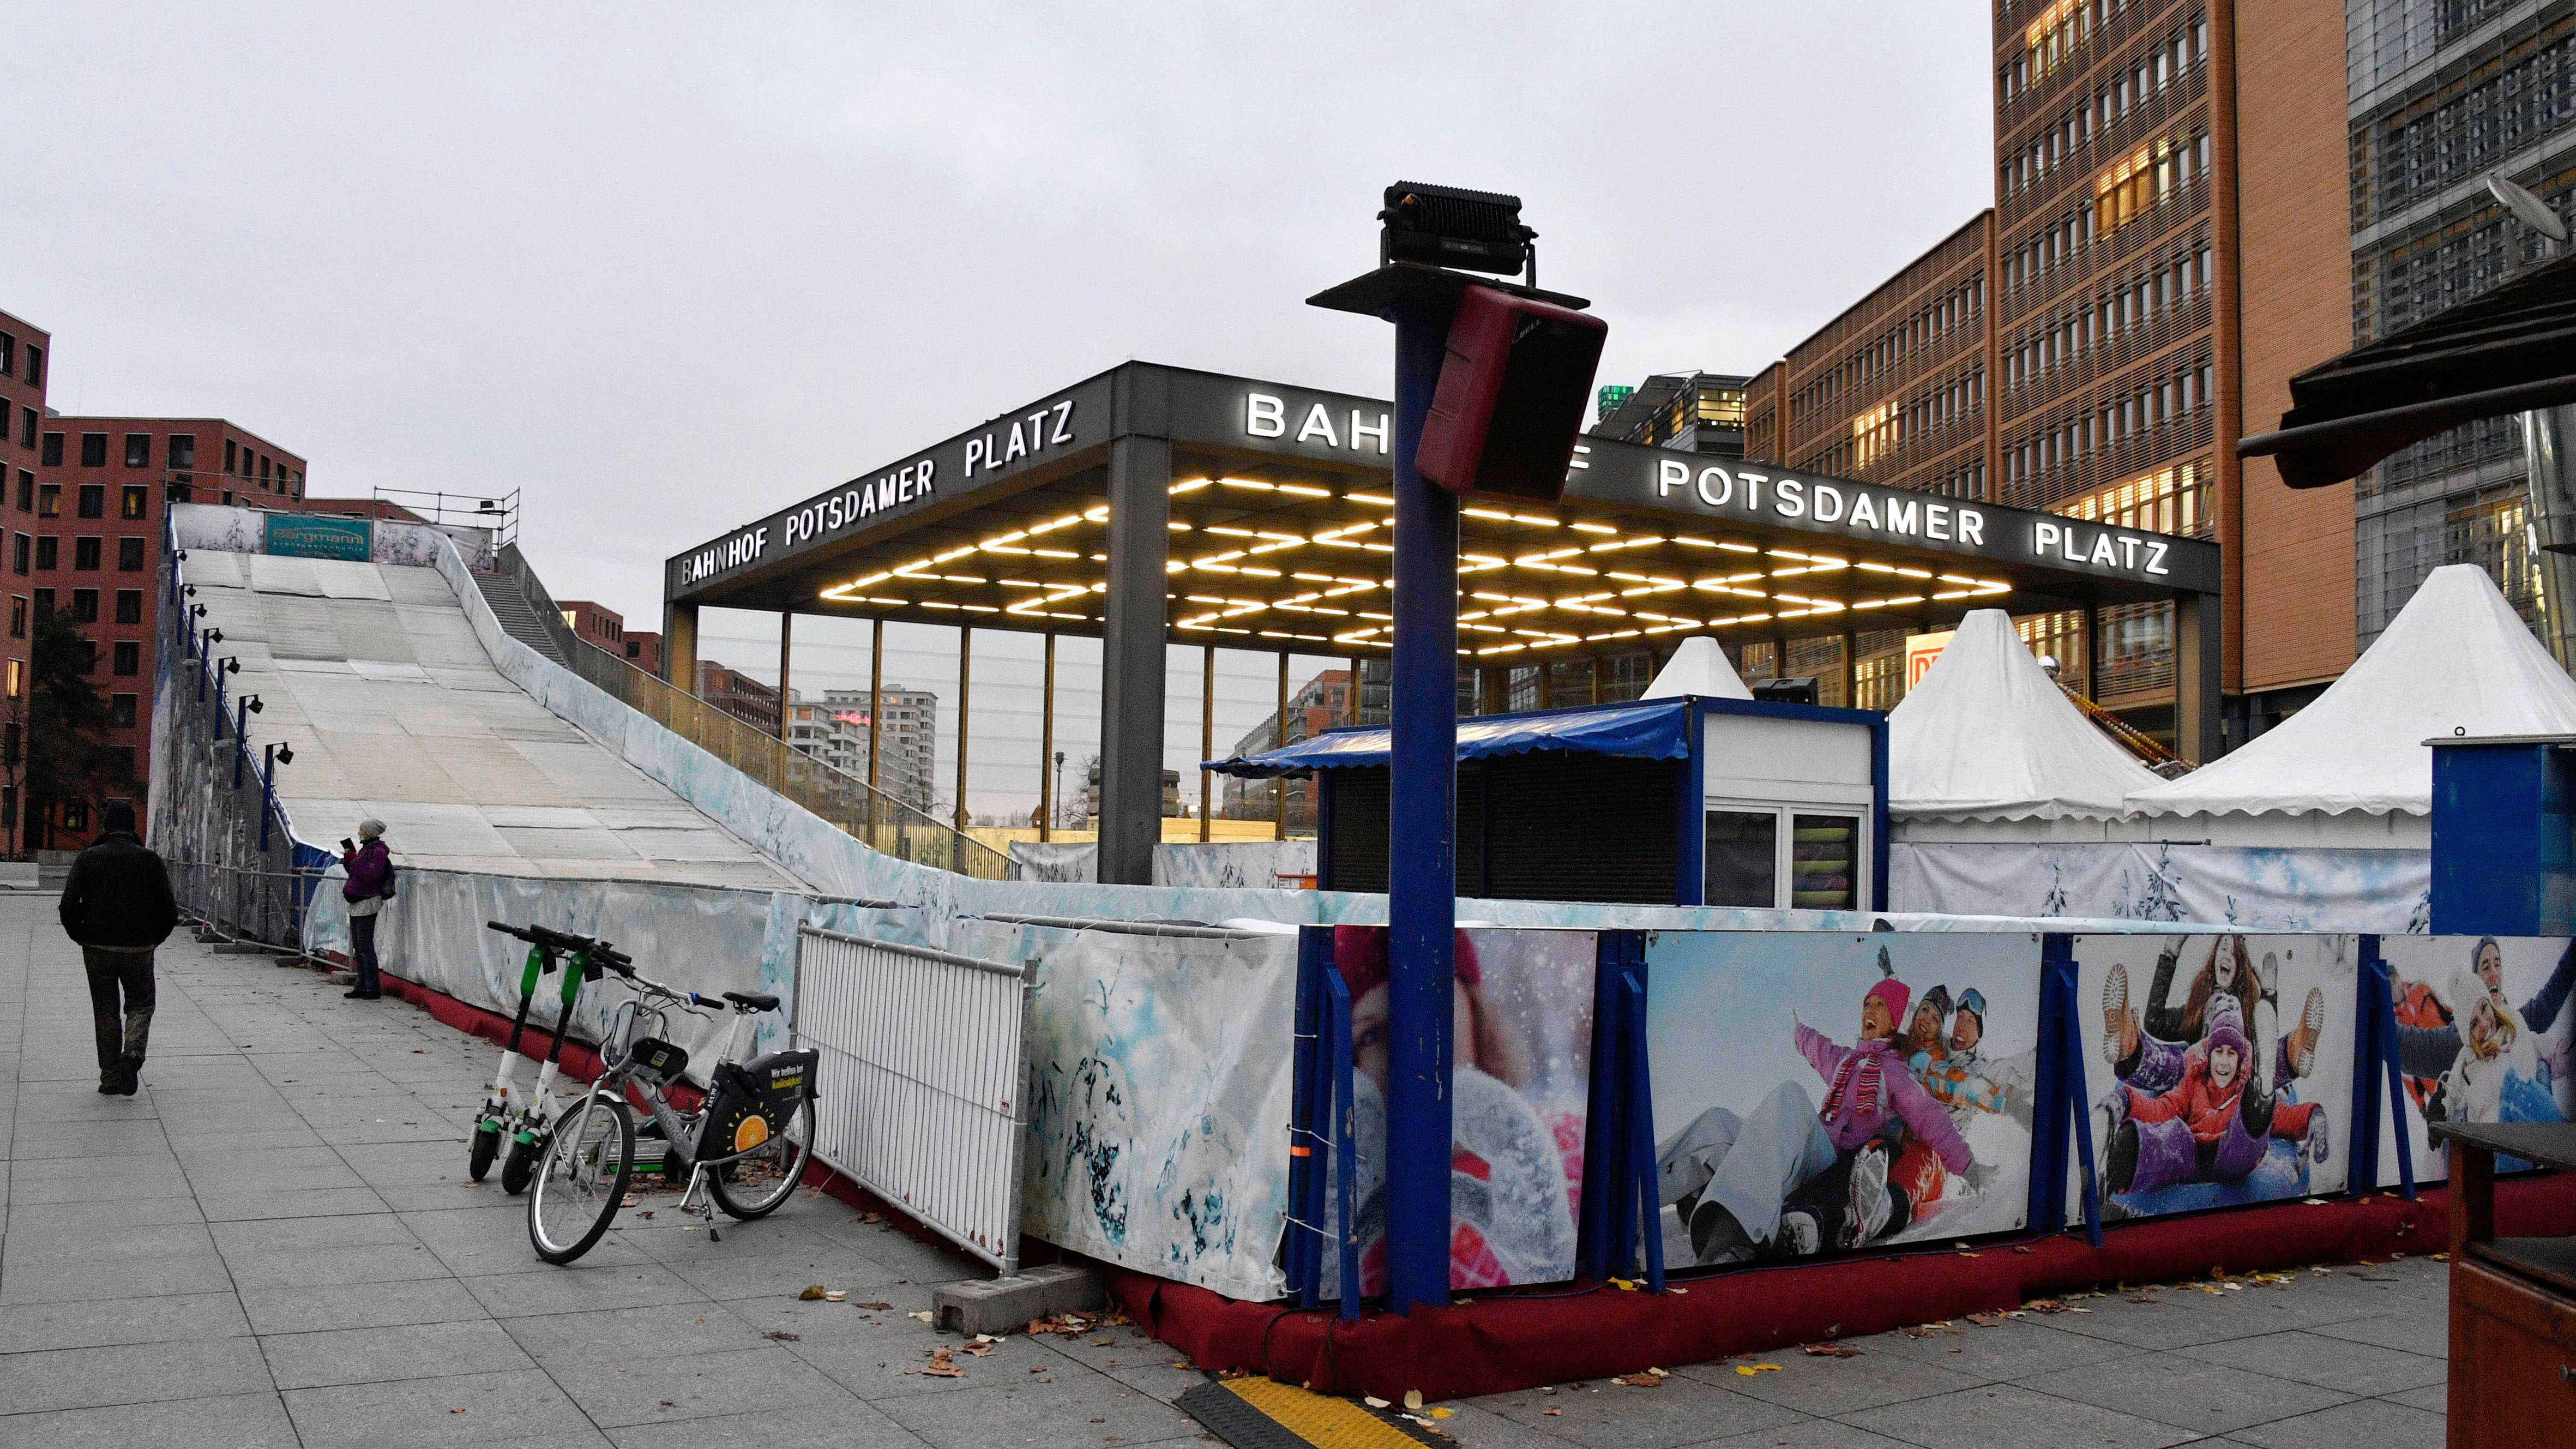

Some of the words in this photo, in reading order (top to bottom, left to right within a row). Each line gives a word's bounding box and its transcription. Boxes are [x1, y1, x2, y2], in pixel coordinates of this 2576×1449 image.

[682, 527, 768, 585] BAHNHOF
[785, 459, 934, 546] POTSDAMER
[965, 400, 1073, 477] PLATZ
[1658, 459, 1984, 546] POTSDAMER
[2035, 522, 2169, 575] PLATZ
